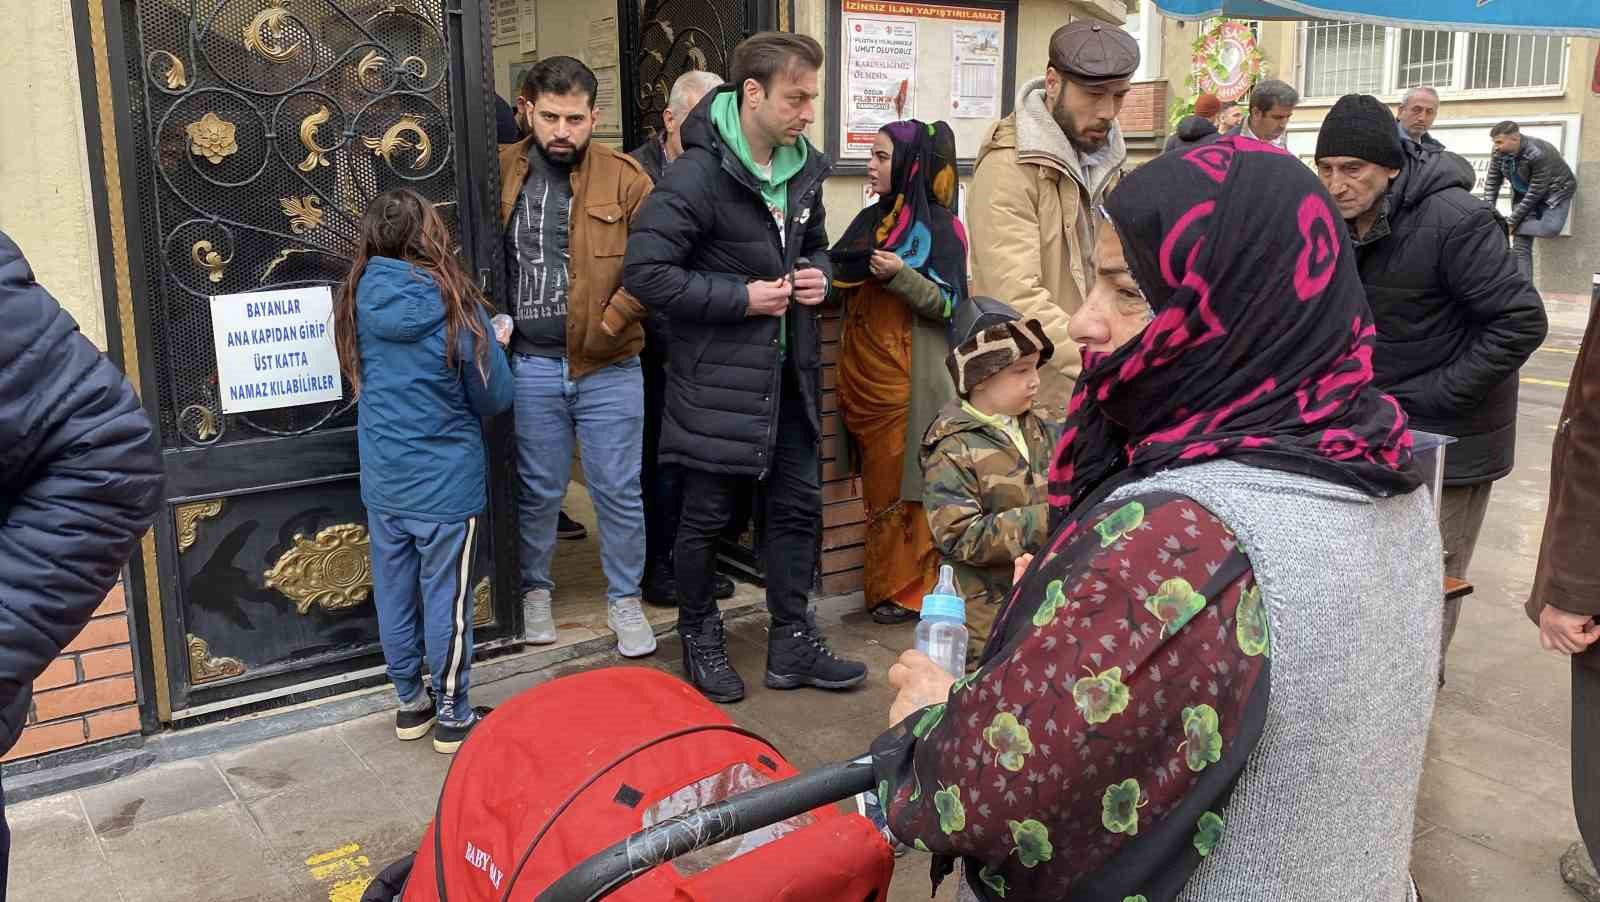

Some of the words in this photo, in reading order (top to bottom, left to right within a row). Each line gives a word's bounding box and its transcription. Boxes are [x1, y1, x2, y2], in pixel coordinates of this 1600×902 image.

[847, 1, 886, 12] İZİNSİZ
[889, 5, 913, 15] İLAN
[917, 7, 999, 20] YAPIŞTIRILAMAZ
[855, 46, 875, 54] UMUT
[876, 47, 912, 55] OLUYORUZ
[247, 299, 301, 318] BAYANLAR
[227, 331, 250, 348] ANA
[251, 326, 297, 345] KAPIDAN
[299, 320, 326, 340] GİRİP
[254, 352, 273, 371] ÜST
[275, 351, 308, 369] KATTA
[230, 382, 269, 401] NAMAZ
[270, 373, 334, 396] KILABİLİRLER
[464, 840, 491, 872] BABY
